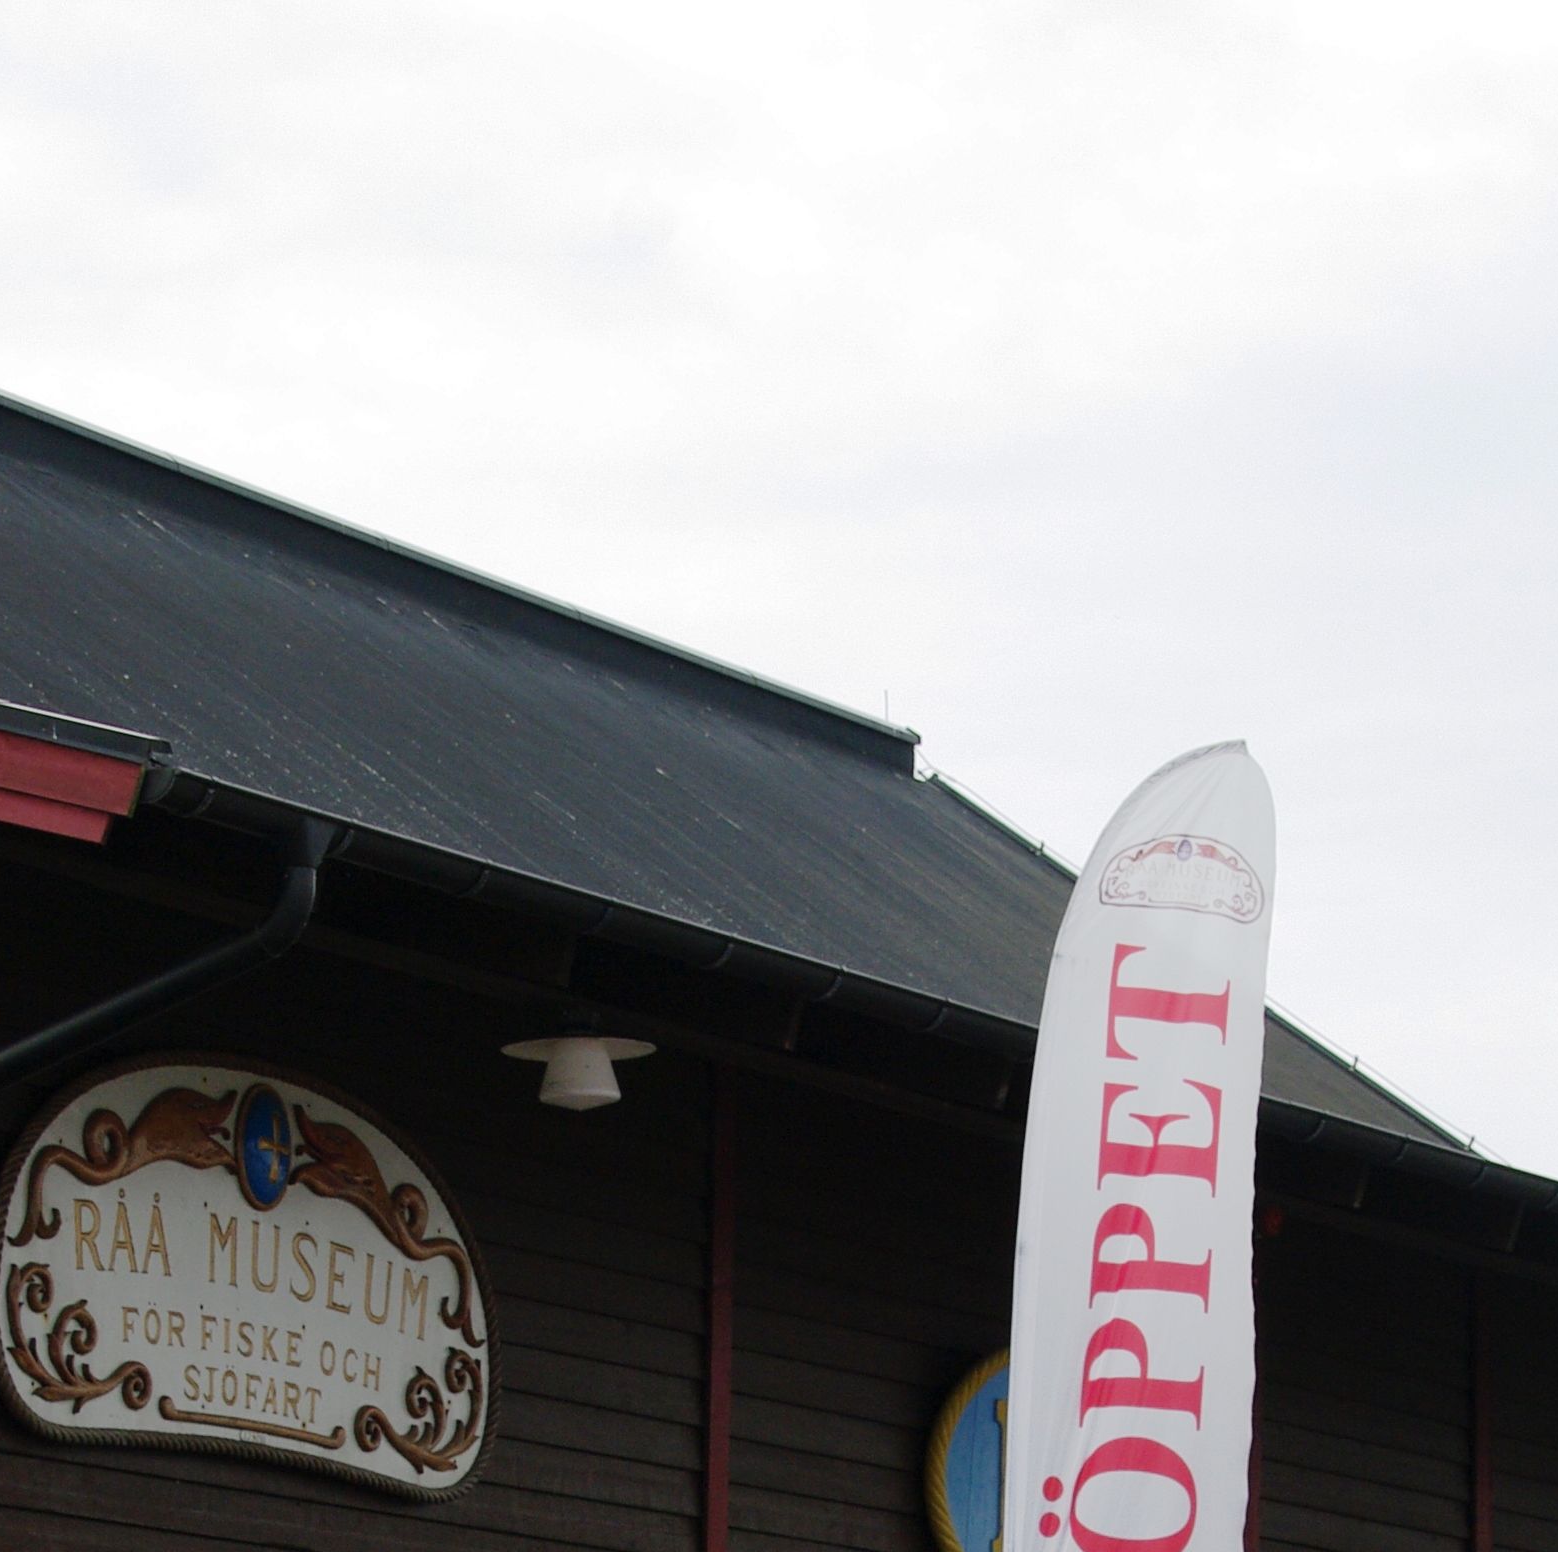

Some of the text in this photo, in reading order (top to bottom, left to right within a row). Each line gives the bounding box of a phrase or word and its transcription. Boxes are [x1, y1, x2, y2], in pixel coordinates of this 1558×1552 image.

[73, 1188, 429, 1341] RÅÅ MUSEUM
[122, 1301, 382, 1392] FÖR FISKE OCH
[183, 1364, 323, 1425] SJÖFART
